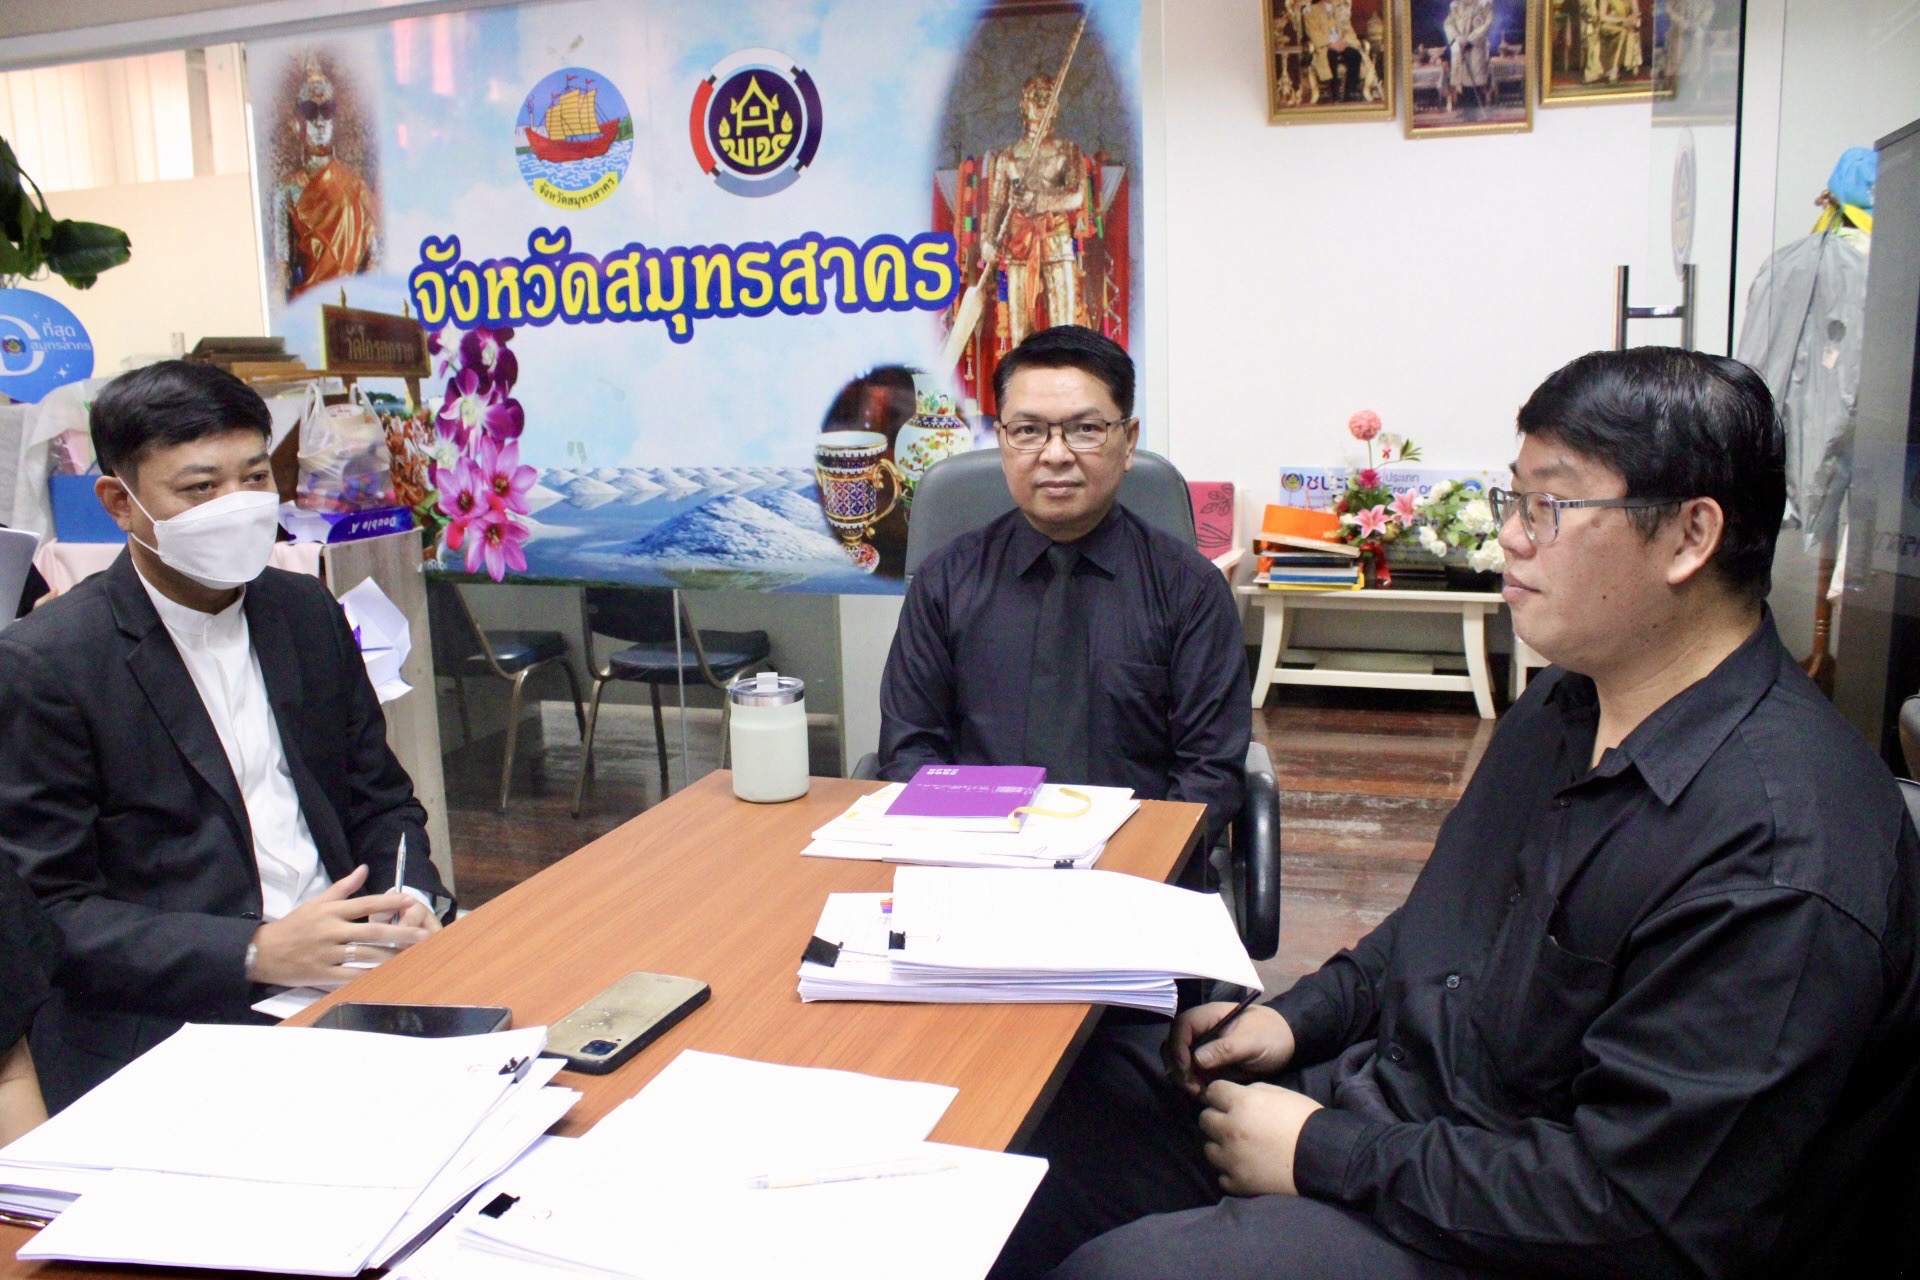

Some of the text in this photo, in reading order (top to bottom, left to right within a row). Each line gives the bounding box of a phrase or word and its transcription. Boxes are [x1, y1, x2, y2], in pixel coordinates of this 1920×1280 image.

[539, 177, 615, 208] จังหวัดสมุทรสาคร
[412, 229, 957, 341] จังหวัดสมุทรสาคร
[42, 317, 77, 341] ที่สุด
[350, 515, 397, 534] Double A
